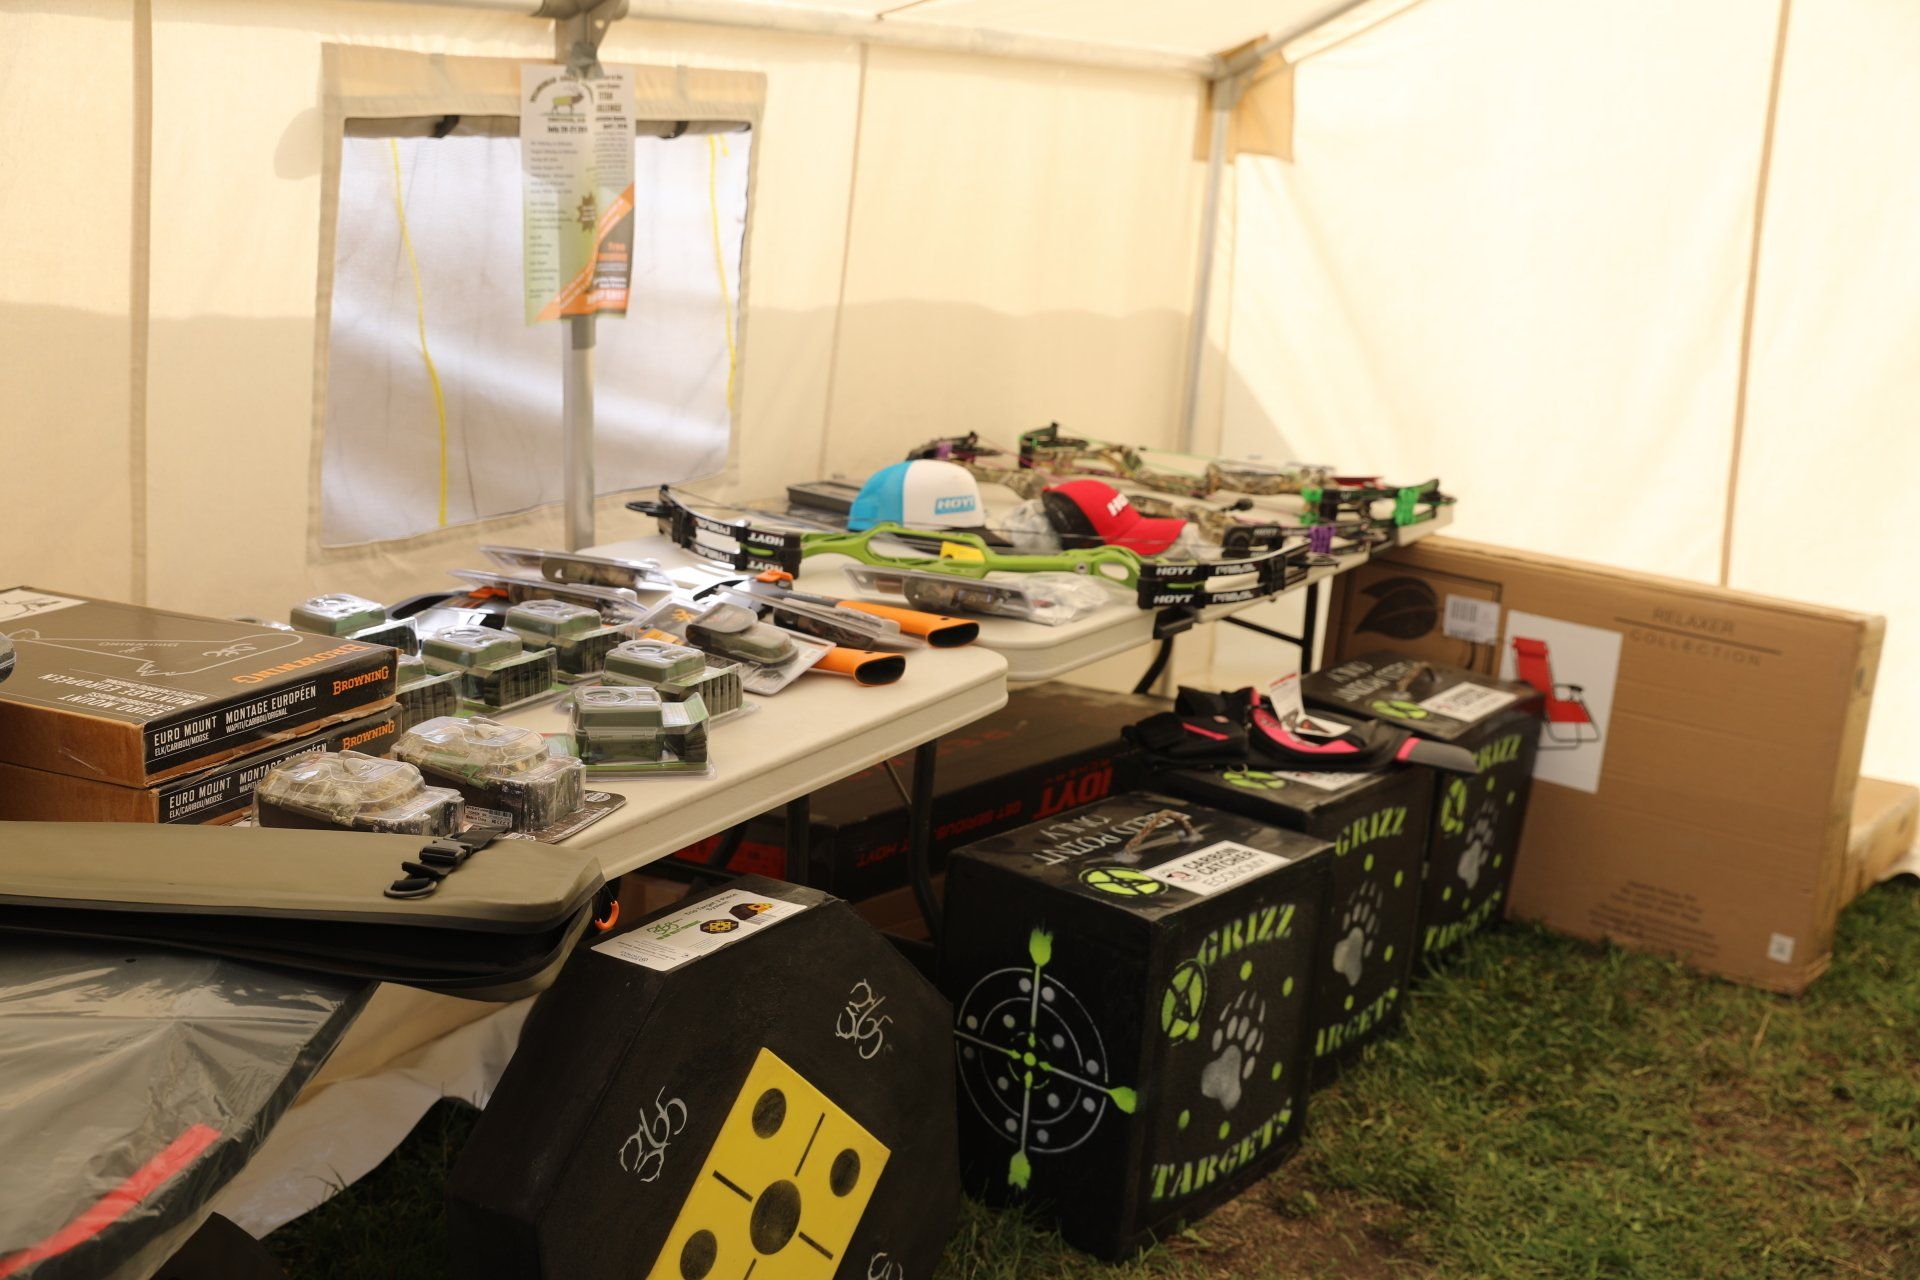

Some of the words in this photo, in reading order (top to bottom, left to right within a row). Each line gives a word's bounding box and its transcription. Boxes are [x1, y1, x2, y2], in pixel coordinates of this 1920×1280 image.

[747, 532, 785, 547] HOYT
[1155, 566, 1197, 576] HOYT
[1153, 593, 1195, 604] HOYT
[1629, 628, 1761, 667] COLLECTION
[231, 643, 371, 684] BROWNING
[332, 665, 390, 697] BROWNING
[57, 693, 115, 709] MOUNT
[123, 687, 197, 706] MONTAGE
[225, 701, 269, 725] MONTAGE
[271, 684, 317, 711] EUROPÉEN
[153, 727, 180, 747] EURO
[183, 715, 217, 738] MOUNT
[225, 707, 288, 734] WAPITI/CARIBOU/ORIGNAL
[341, 719, 396, 751] BROWNING
[154, 732, 210, 757] ELK/CARIBOU/MOOSE
[169, 788, 195, 809] EURO
[198, 776, 232, 799] MOUNT
[169, 793, 223, 819] ELK/CARIBOU/MOOSE
[1040, 814, 1112, 841] ONLY
[1335, 806, 1407, 857] GRIZZ
[1032, 829, 1123, 866] POINT
[1182, 847, 1241, 870] CARBON
[1197, 850, 1259, 875] CATCHER
[1197, 903, 1296, 967] GRIZZ
[1151, 1096, 1292, 1199] TARGETS
